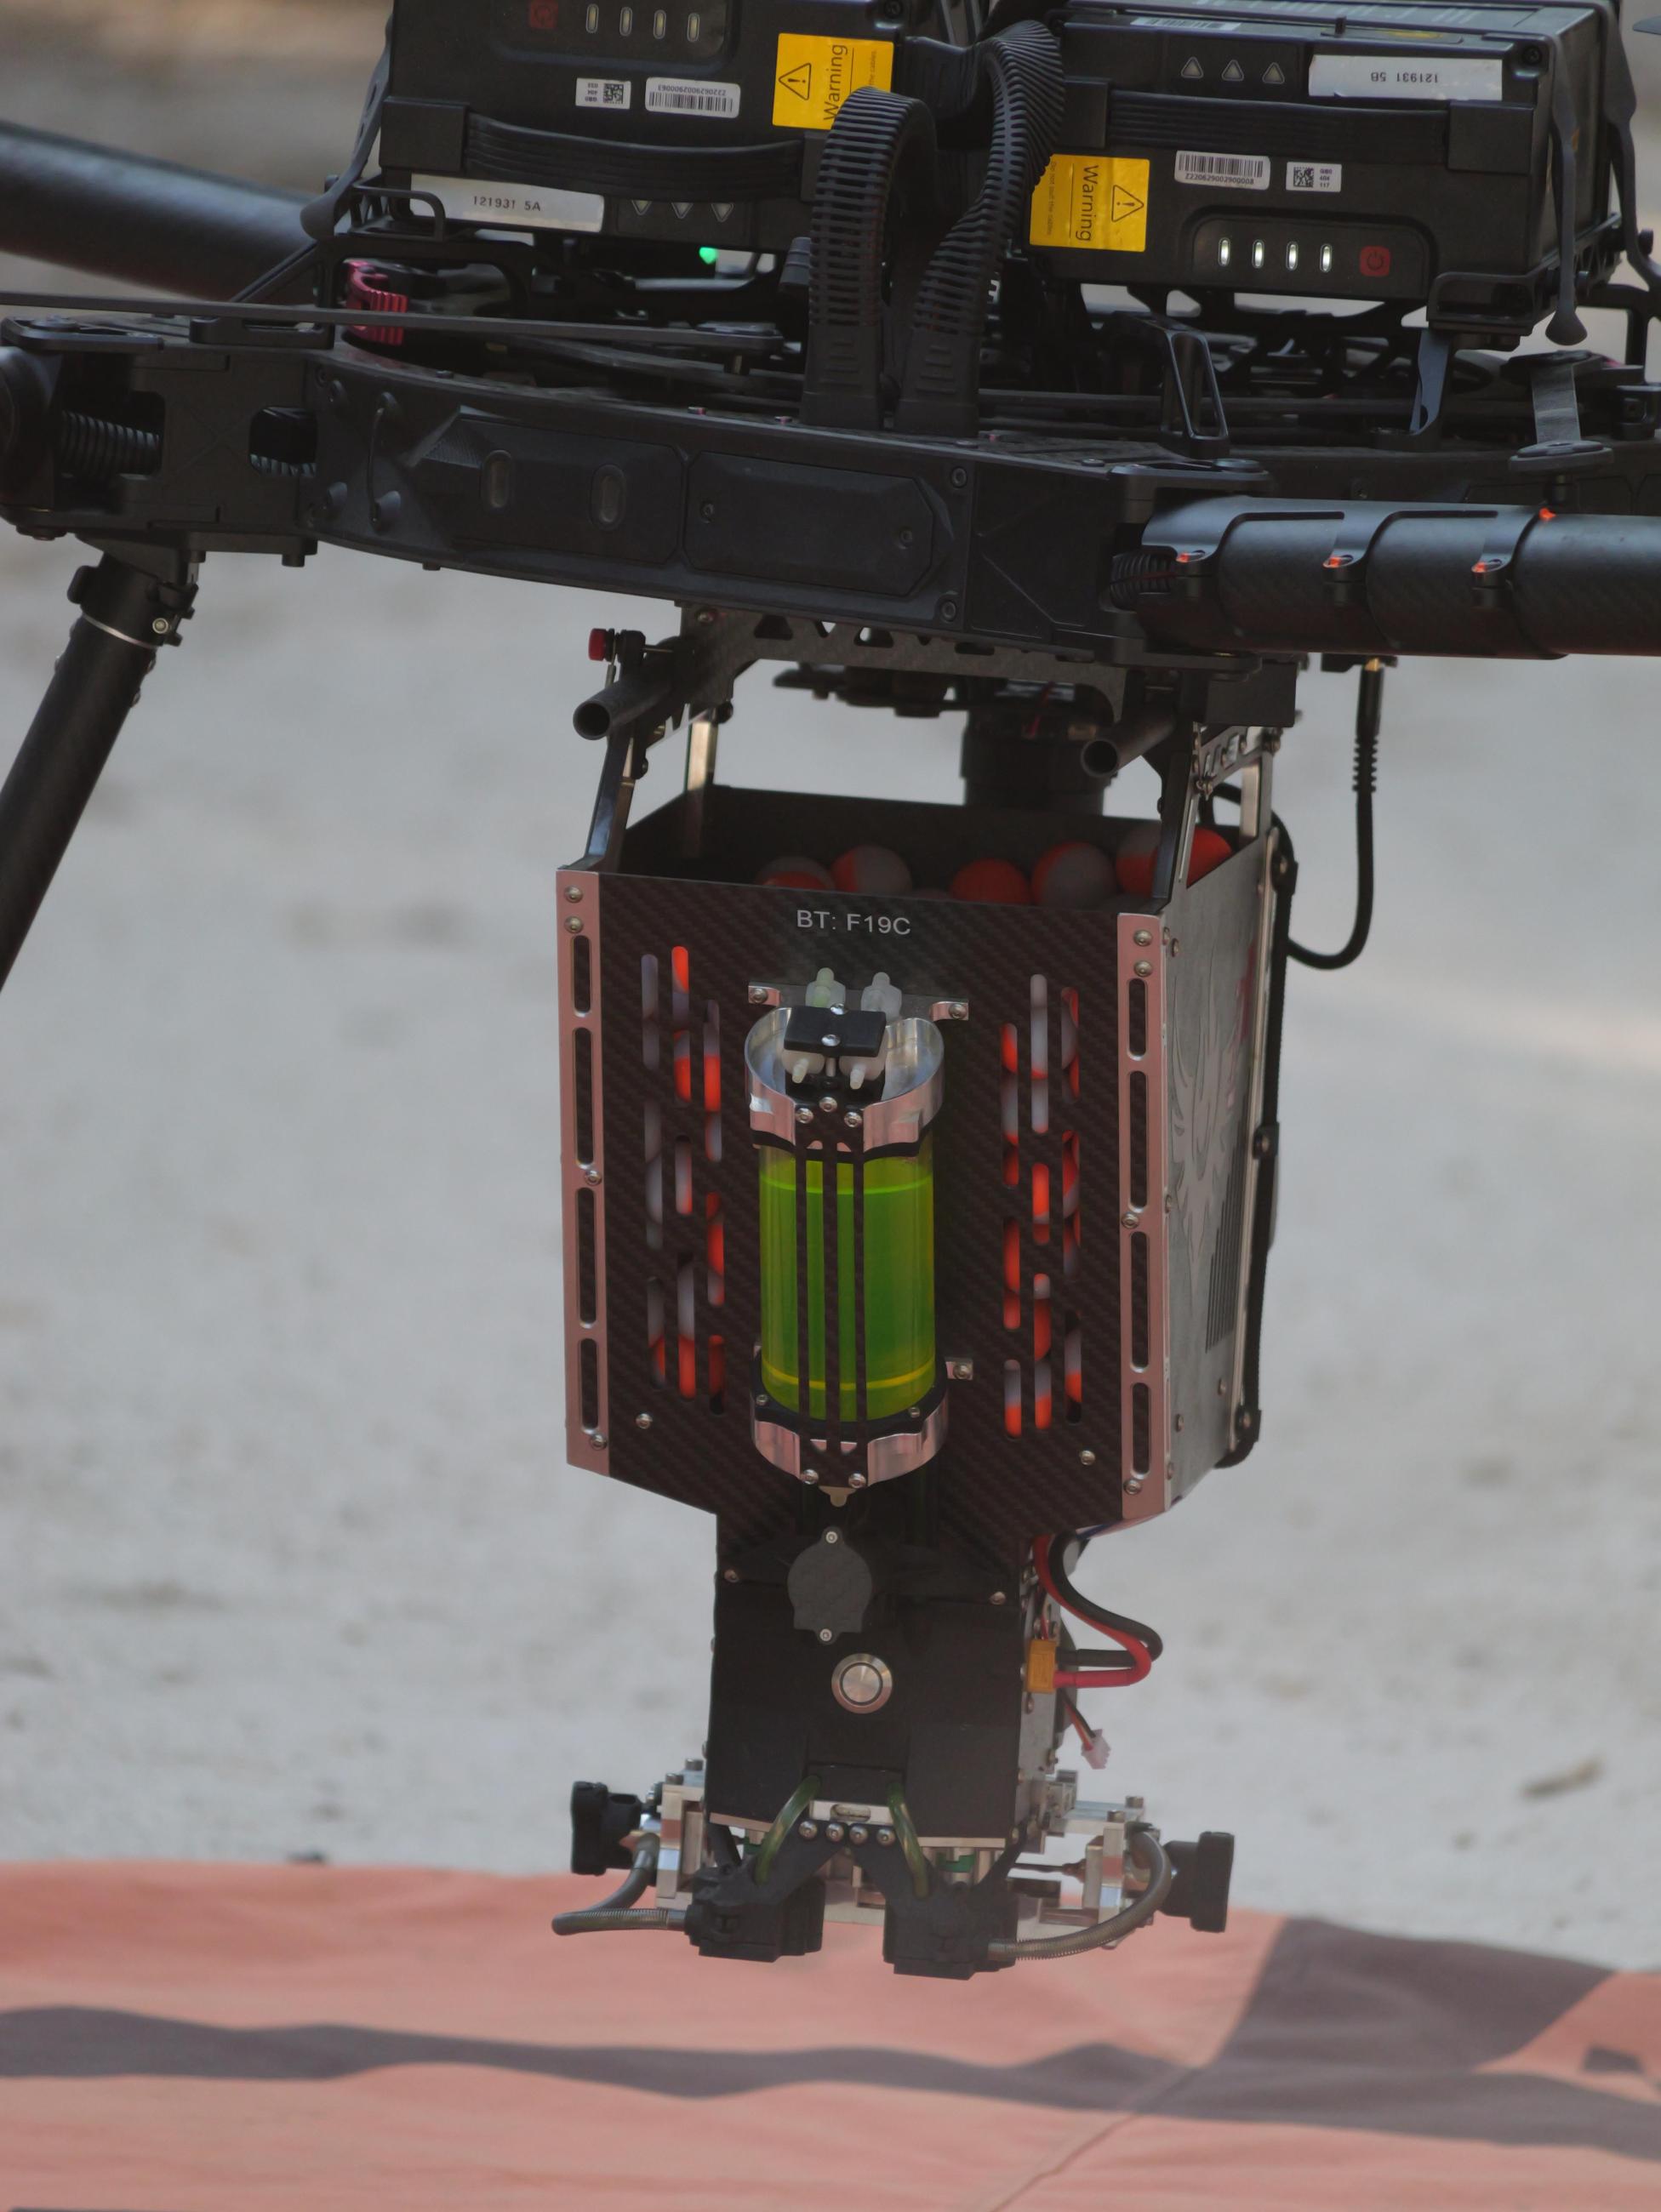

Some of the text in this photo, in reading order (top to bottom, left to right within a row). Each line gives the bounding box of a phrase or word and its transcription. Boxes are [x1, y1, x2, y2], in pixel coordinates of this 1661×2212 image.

[823, 44, 848, 121] Warning
[1370, 71, 1439, 83] 121931 5B
[473, 195, 541, 212] 121931 5A
[1076, 165, 1099, 242] Warning
[796, 909, 911, 935] BT: F19C
